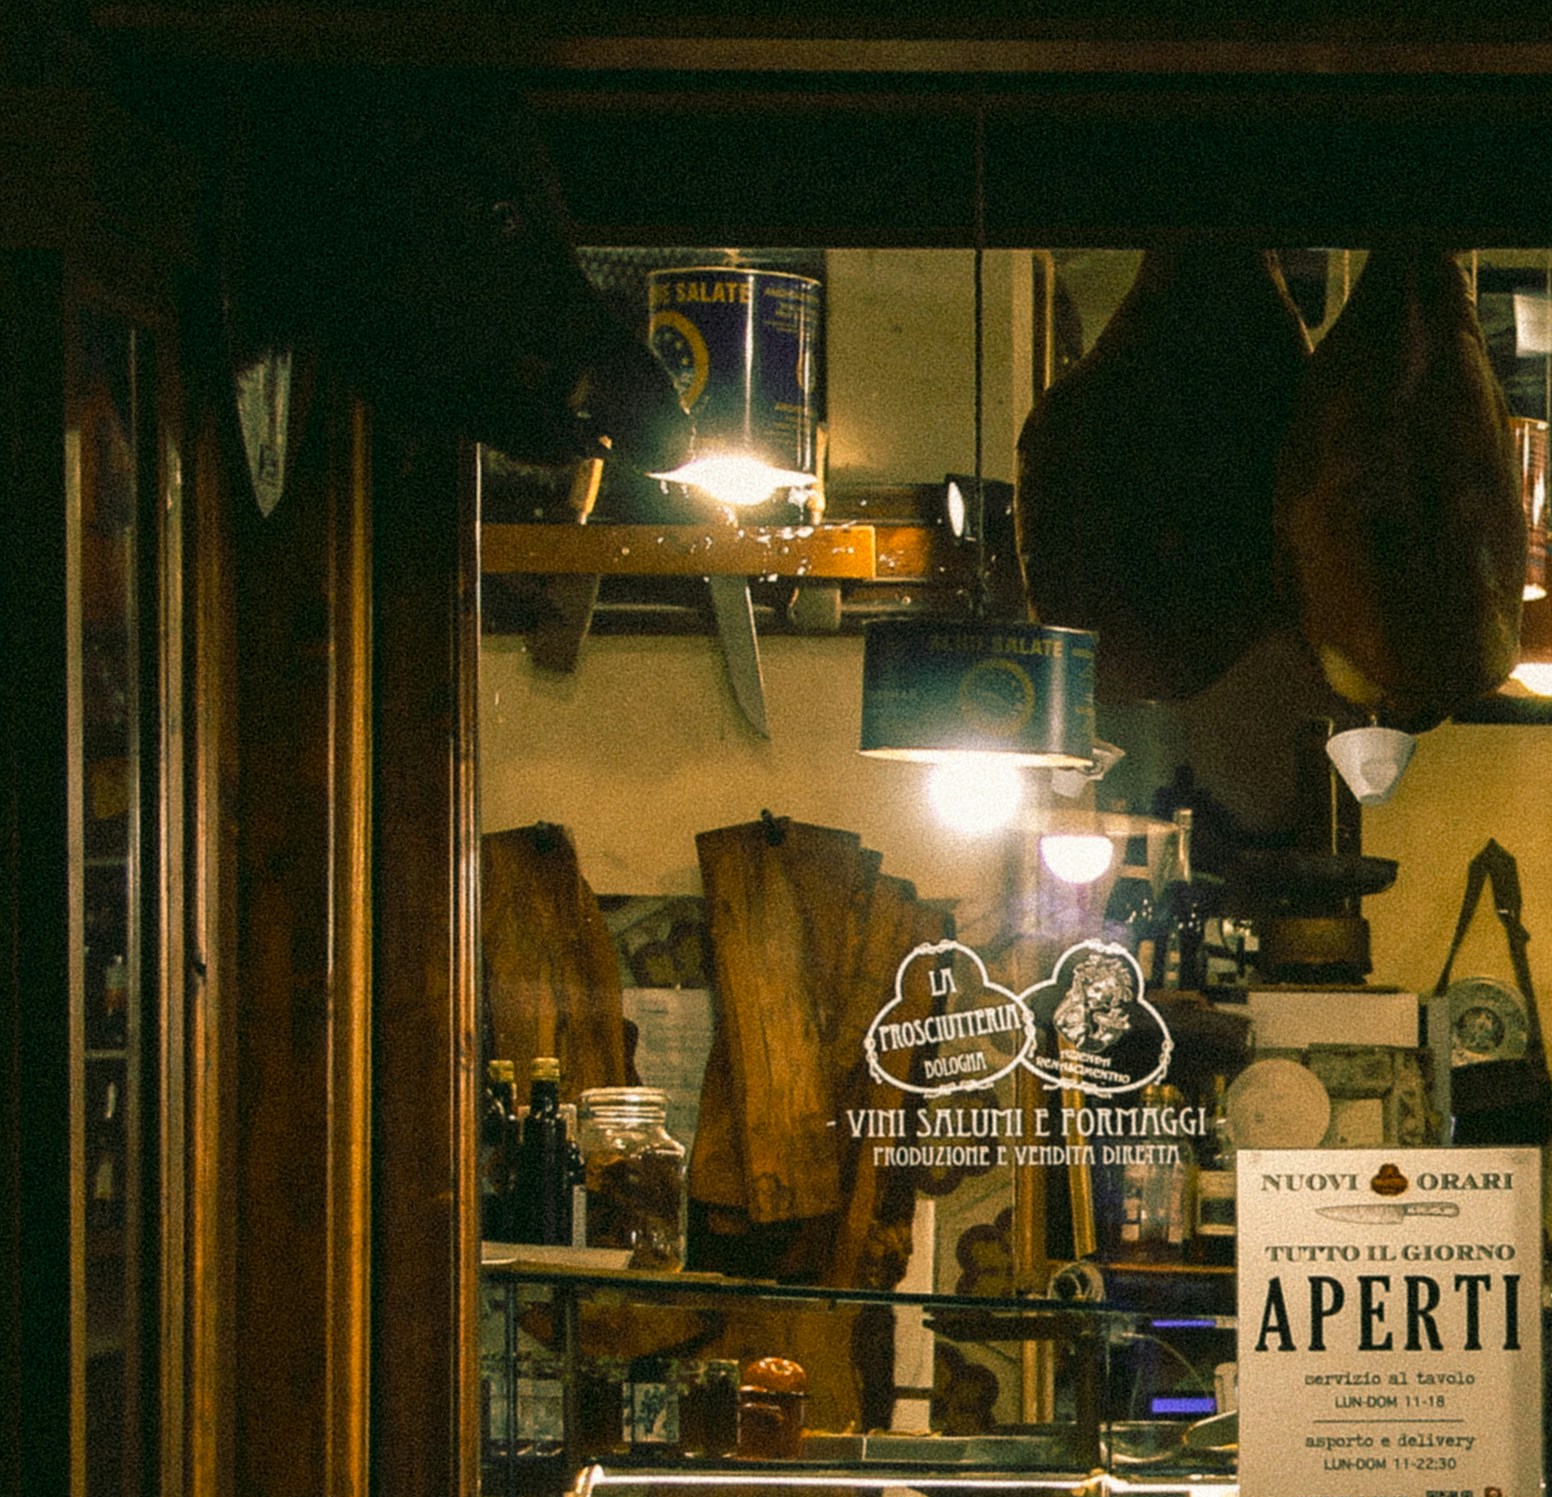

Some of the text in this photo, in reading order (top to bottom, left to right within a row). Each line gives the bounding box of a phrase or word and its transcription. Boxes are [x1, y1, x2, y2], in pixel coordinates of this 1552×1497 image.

[675, 282, 750, 304] SALATE
[929, 968, 956, 997] LA
[879, 1004, 1022, 1052] PROSCIUTTERIA
[924, 1051, 987, 1079] BOLOGNA
[847, 1107, 1206, 1138] VINI SALUMI E FORMAGGI
[874, 1145, 1180, 1166] PRODUZIONE E VENDITA DIRETTA
[1262, 1172, 1514, 1192] NUOVI ORARI
[1265, 1244, 1515, 1262] TUTTO IL GIORNO
[1255, 1274, 1521, 1352] APERTI
[1305, 1370, 1475, 1387] servizio al tavolo
[1335, 1395, 1445, 1409] LUN-DOM 11-18
[1305, 1432, 1476, 1452] asporto e delivery
[1324, 1457, 1457, 1471] LUN-DOM 11-22:30
